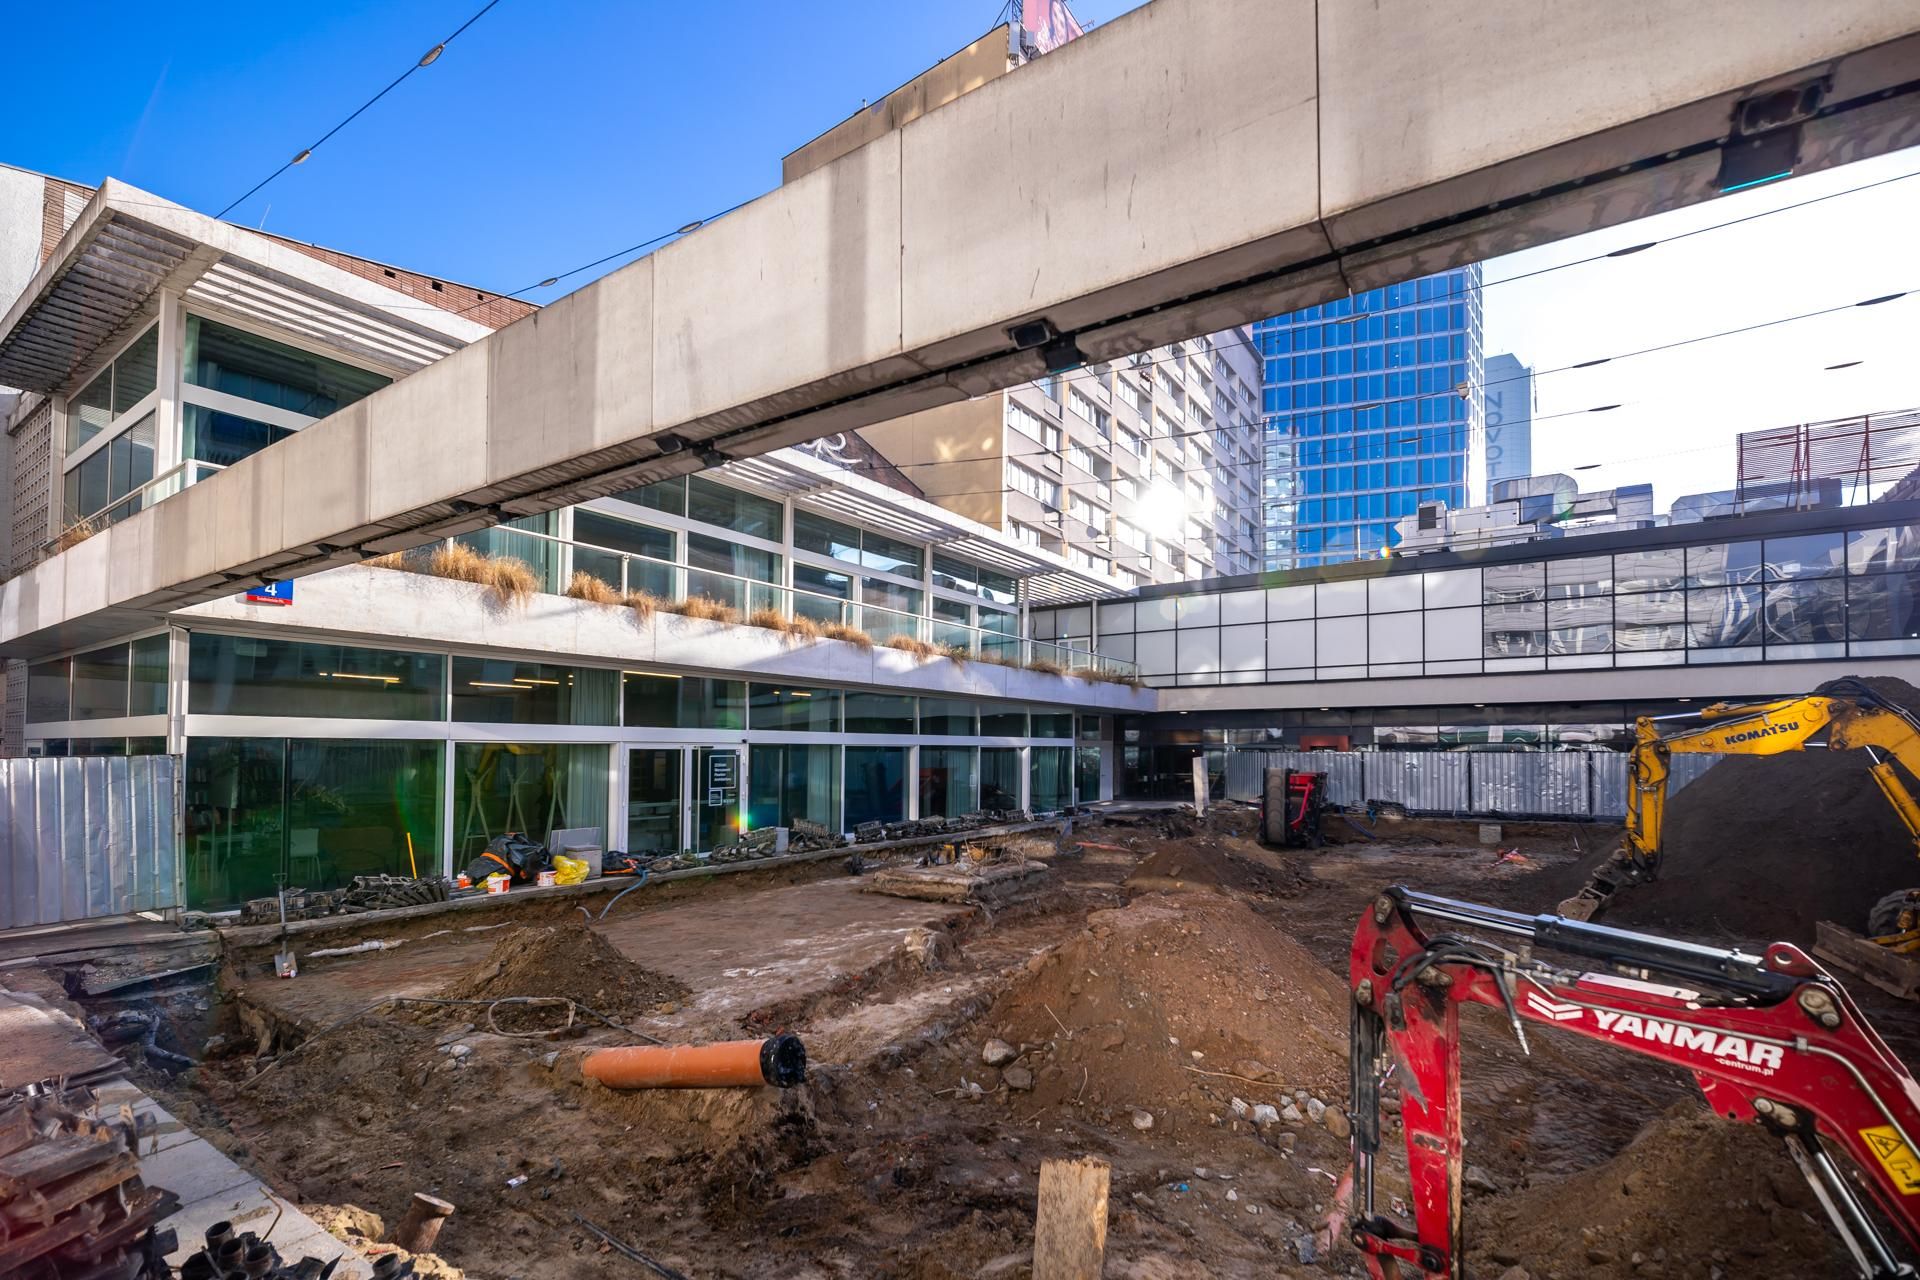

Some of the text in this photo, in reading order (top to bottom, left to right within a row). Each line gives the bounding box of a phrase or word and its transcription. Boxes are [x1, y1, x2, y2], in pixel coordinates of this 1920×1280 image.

[1485, 391, 1503, 504] NOVOT
[264, 583, 278, 596] 4
[1724, 721, 1800, 745] KOMATSU
[1591, 1008, 1785, 1070] YANMAR
